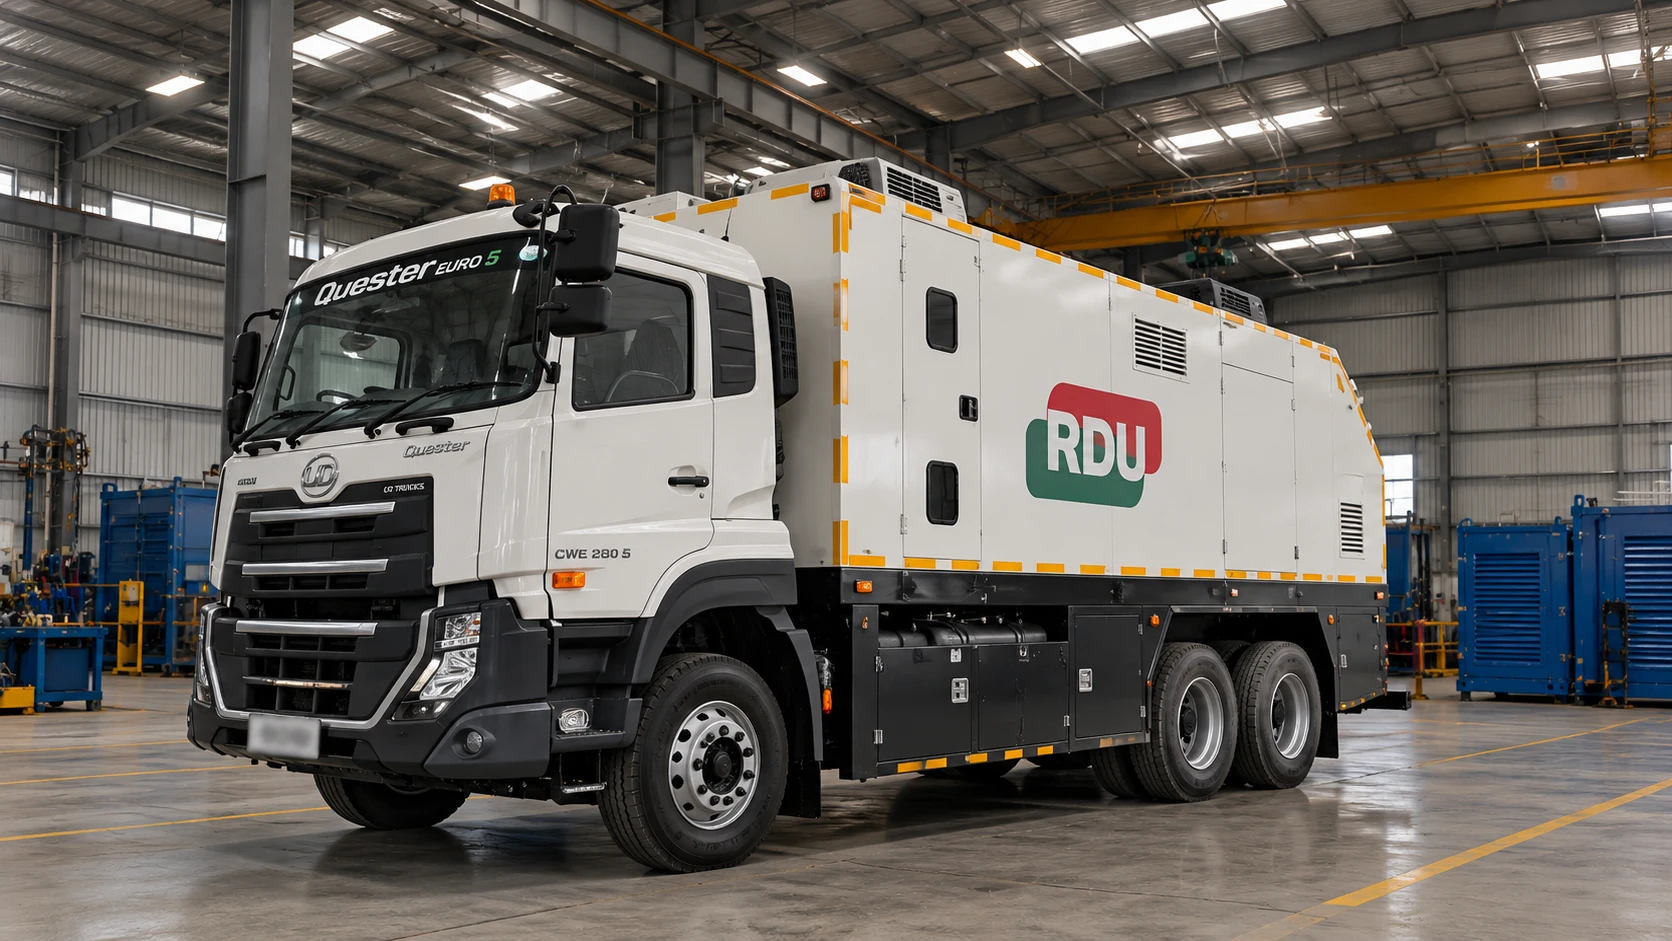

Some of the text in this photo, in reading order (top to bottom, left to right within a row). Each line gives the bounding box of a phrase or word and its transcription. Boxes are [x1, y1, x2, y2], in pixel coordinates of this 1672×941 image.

[314, 259, 437, 306] Quester
[435, 254, 483, 276] EURO
[484, 249, 502, 267] 5
[403, 441, 471, 459] Quester
[1047, 408, 1146, 483] RDU
[554, 548, 632, 560] CWE 280 5
